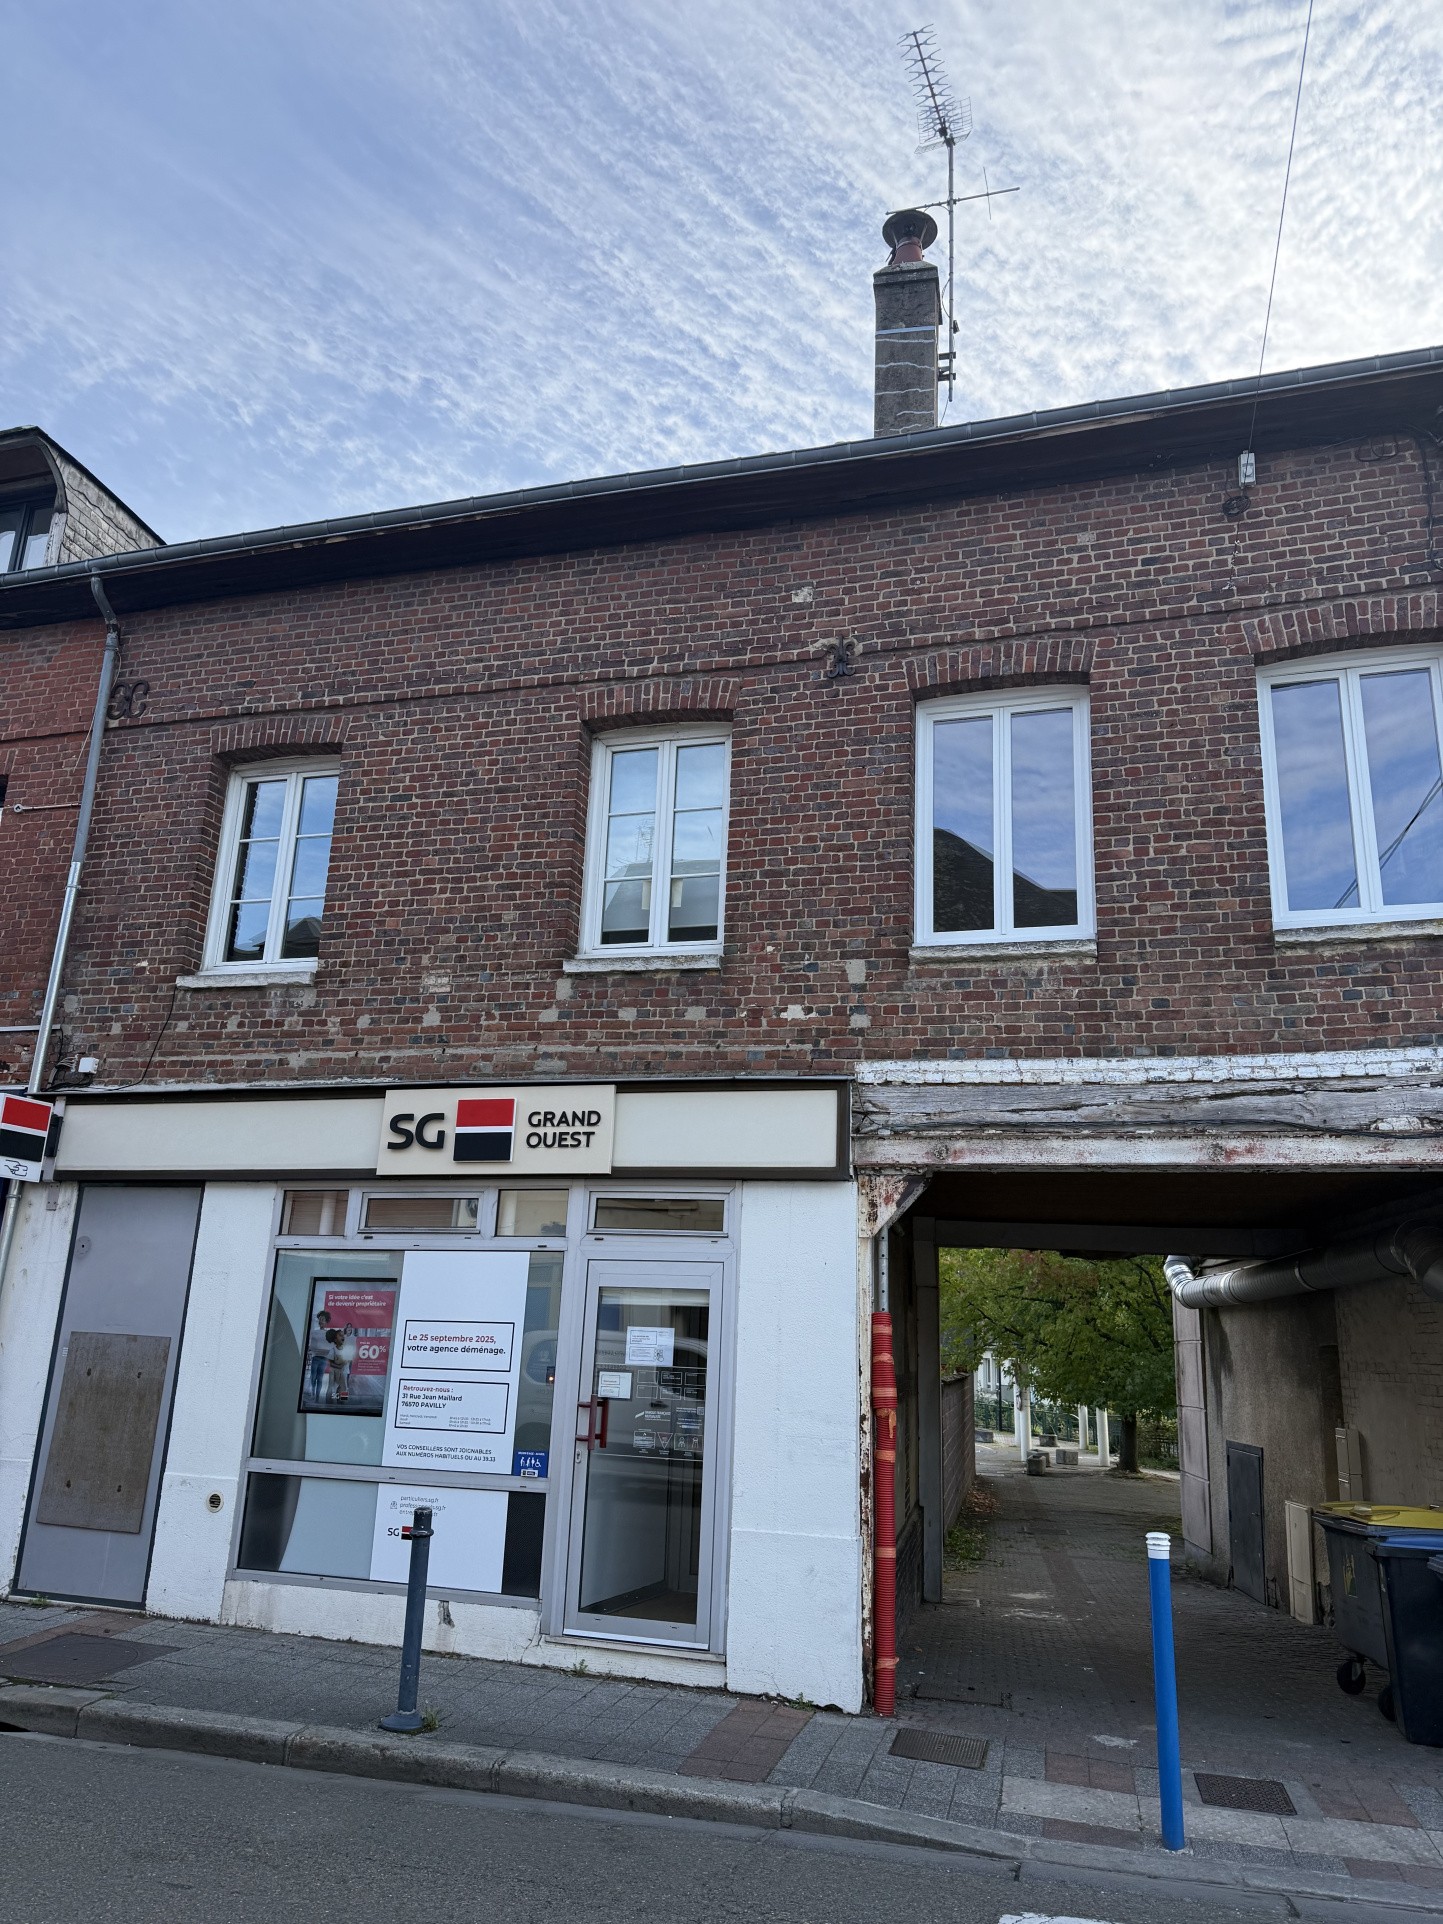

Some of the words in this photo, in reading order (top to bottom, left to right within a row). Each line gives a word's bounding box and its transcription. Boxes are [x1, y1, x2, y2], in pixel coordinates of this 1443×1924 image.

[528, 1110, 601, 1128] GRAND
[387, 1113, 446, 1149] SG
[526, 1132, 595, 1148] OUEST
[408, 1333, 418, 1341] Le
[419, 1333, 428, 1342] 25
[430, 1334, 474, 1344] septembre
[475, 1335, 497, 1345] 2025,
[358, 1344, 386, 1360] 60%
[429, 1346, 459, 1354] agence
[460, 1345, 506, 1356] déménage.
[402, 1385, 450, 1393] Retrouvez-nous
[437, 1394, 463, 1402] Maillard
[408, 1444, 443, 1452] CONSEILLERS
[459, 1447, 492, 1455] JOIGNABLES
[387, 1527, 400, 1537] SG
